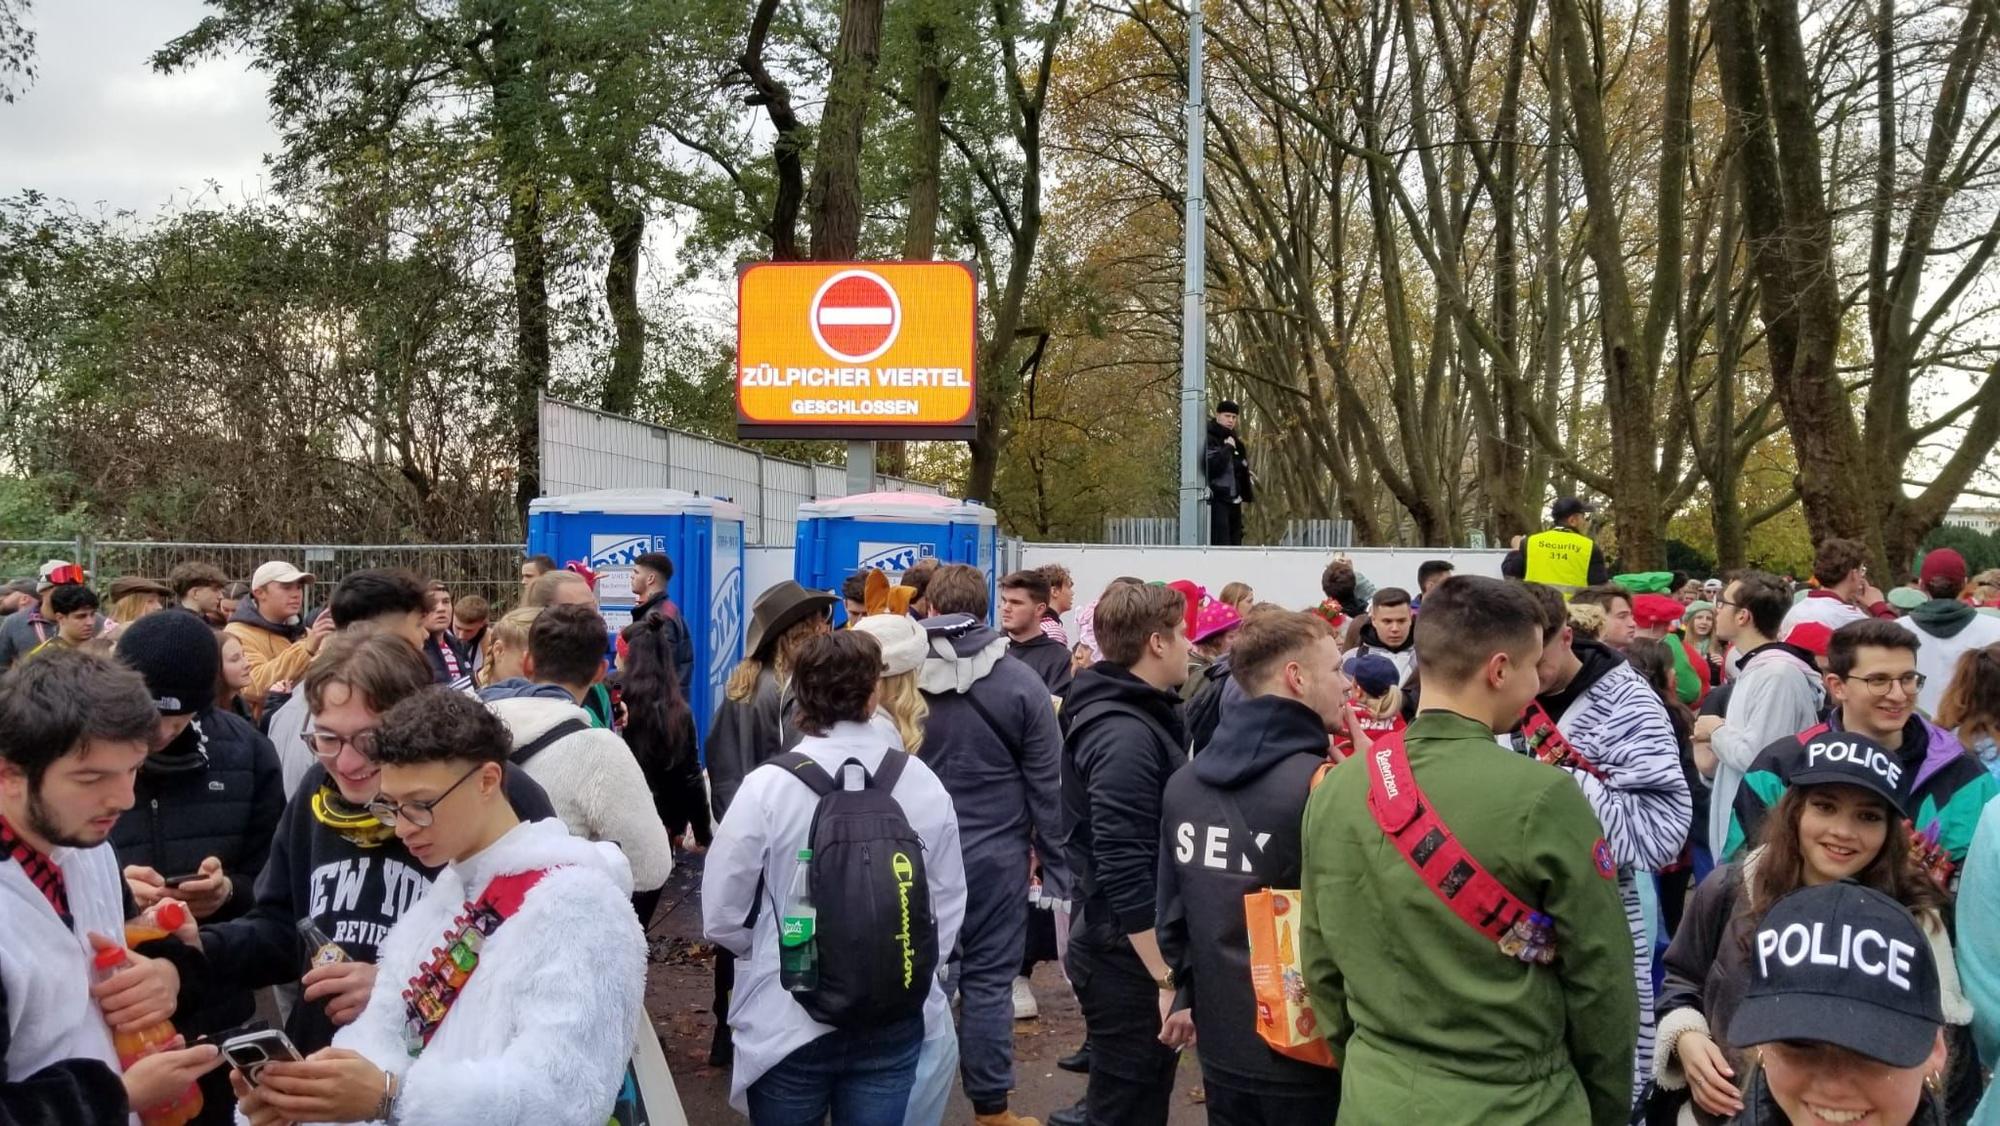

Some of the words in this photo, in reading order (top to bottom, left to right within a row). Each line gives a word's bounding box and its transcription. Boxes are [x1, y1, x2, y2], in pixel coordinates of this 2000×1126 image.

[741, 364, 871, 387] ZÜLPICHER
[877, 367, 970, 387] VIERTEL
[791, 399, 919, 415] GESCHLOSSEN
[1538, 541, 1582, 553] Security
[1550, 552, 1568, 560] 314
[1809, 741, 1902, 789] POLICE
[310, 857, 370, 919] EW
[893, 852, 915, 989] Champion
[1757, 922, 1915, 991] POLICE
